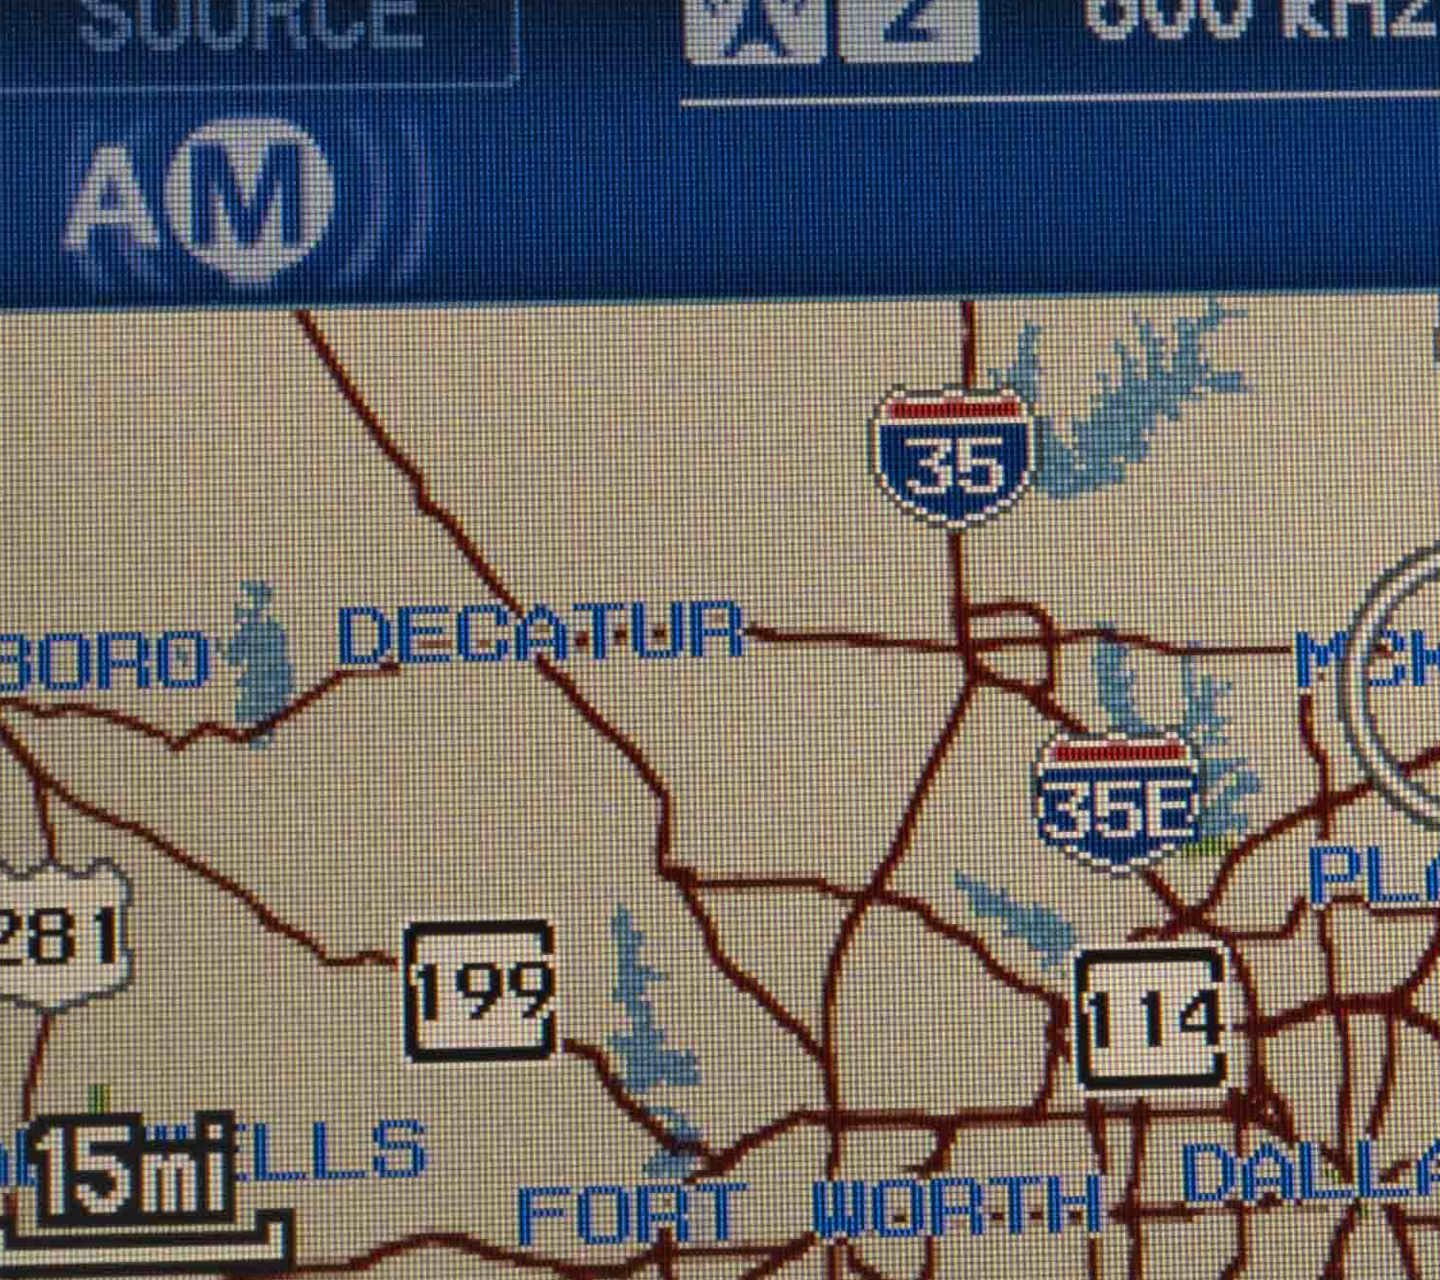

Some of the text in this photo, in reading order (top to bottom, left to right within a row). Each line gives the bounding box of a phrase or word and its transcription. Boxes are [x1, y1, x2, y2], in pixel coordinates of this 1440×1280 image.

[904, 436, 1005, 495] 35
[337, 600, 747, 666] DECATUR
[1040, 777, 1197, 841] 35E
[412, 960, 556, 1022] 199
[1083, 988, 1227, 1050] 114
[517, 1173, 1105, 1248] FORT WORTH
